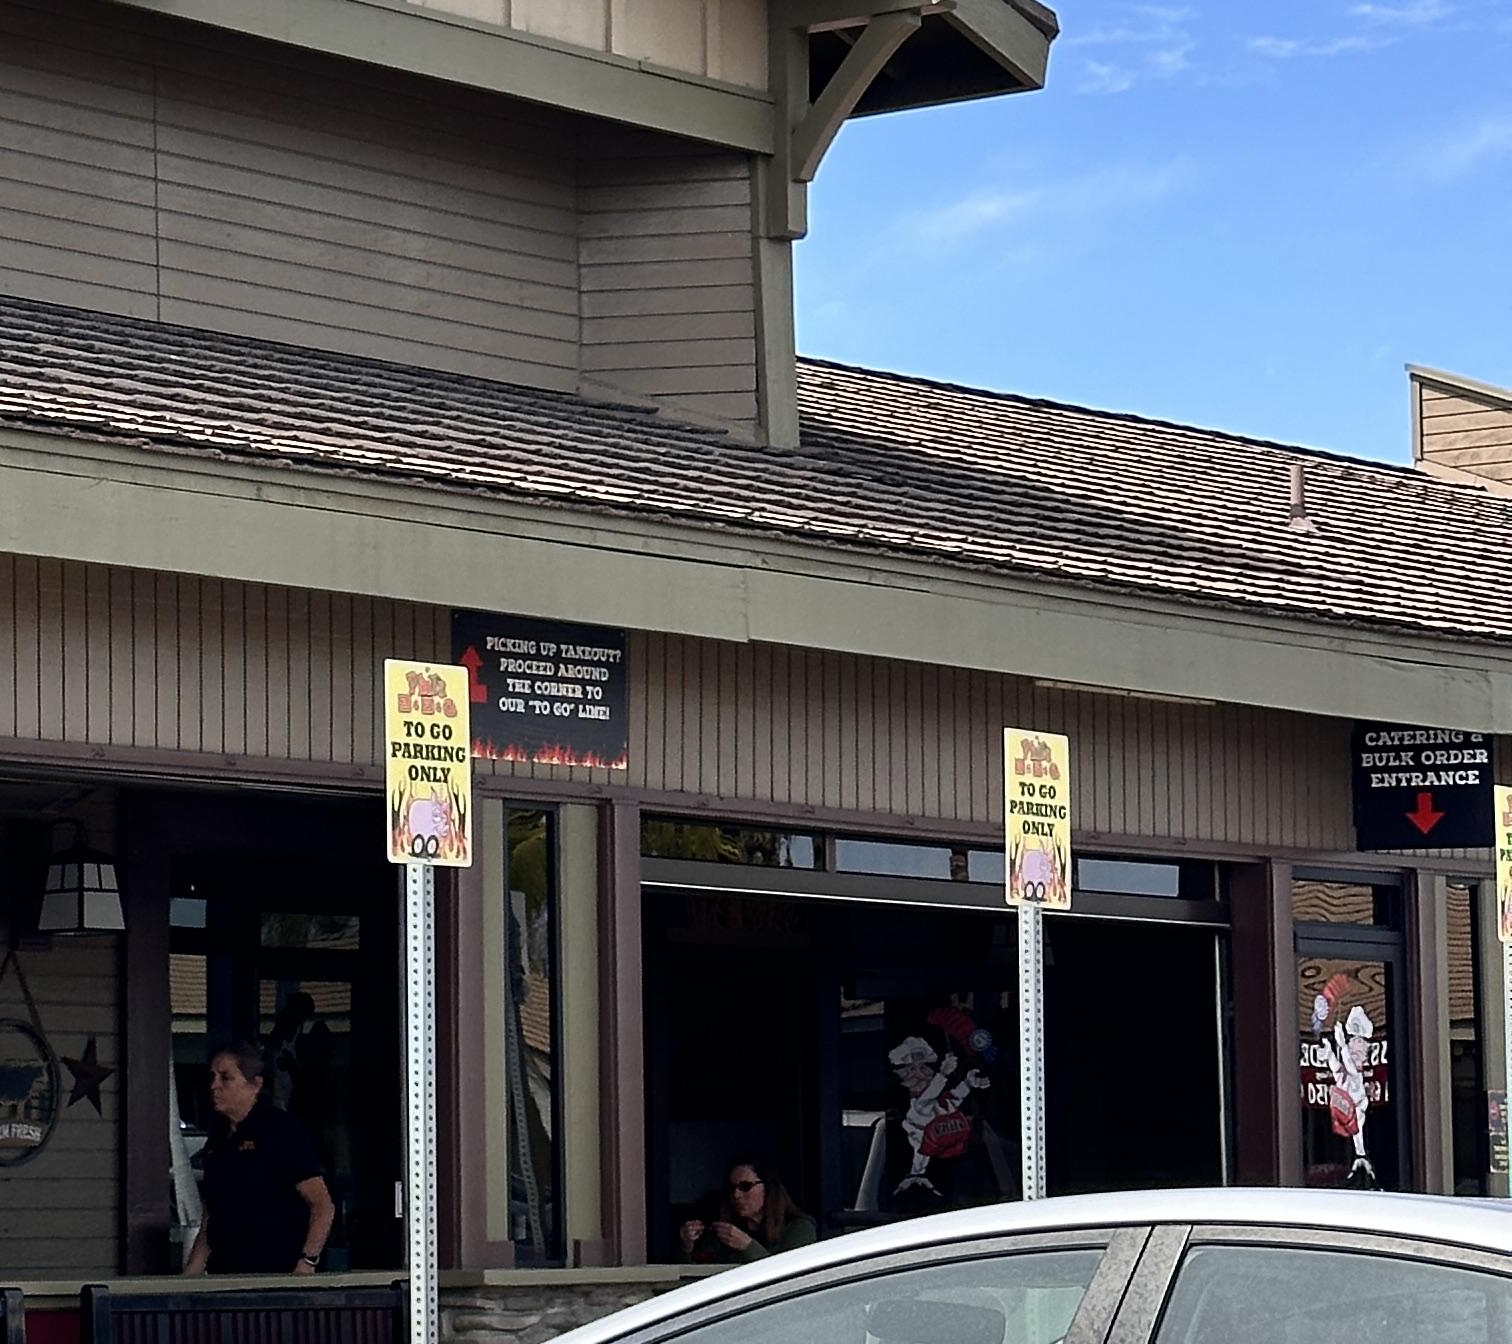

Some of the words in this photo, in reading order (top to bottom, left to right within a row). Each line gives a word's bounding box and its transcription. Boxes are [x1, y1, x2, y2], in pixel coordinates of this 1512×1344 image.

[486, 636, 536, 654] PICKING
[539, 642, 557, 656] UP
[560, 644, 621, 663] TAKEOUT?
[499, 658, 554, 676] PROCEED
[557, 663, 609, 681] AROUND
[506, 678, 532, 693] THE
[534, 681, 583, 698] CORNER
[586, 685, 602, 700] TO
[499, 697, 525, 713] OUR
[578, 704, 610, 720] LINE!
[403, 720, 425, 738] TO
[430, 723, 453, 740] GO
[1365, 729, 1464, 746] CATERING
[391, 741, 466, 763] PARKING
[1361, 751, 1415, 767] BULK
[1420, 749, 1488, 765] ORDER
[408, 764, 451, 784] ONLY
[1370, 770, 1480, 787] ENTRANCE
[1019, 781, 1035, 797] TO
[1039, 784, 1056, 799] GO
[1009, 799, 1066, 819] PARKING
[1022, 820, 1055, 837] ONLY
